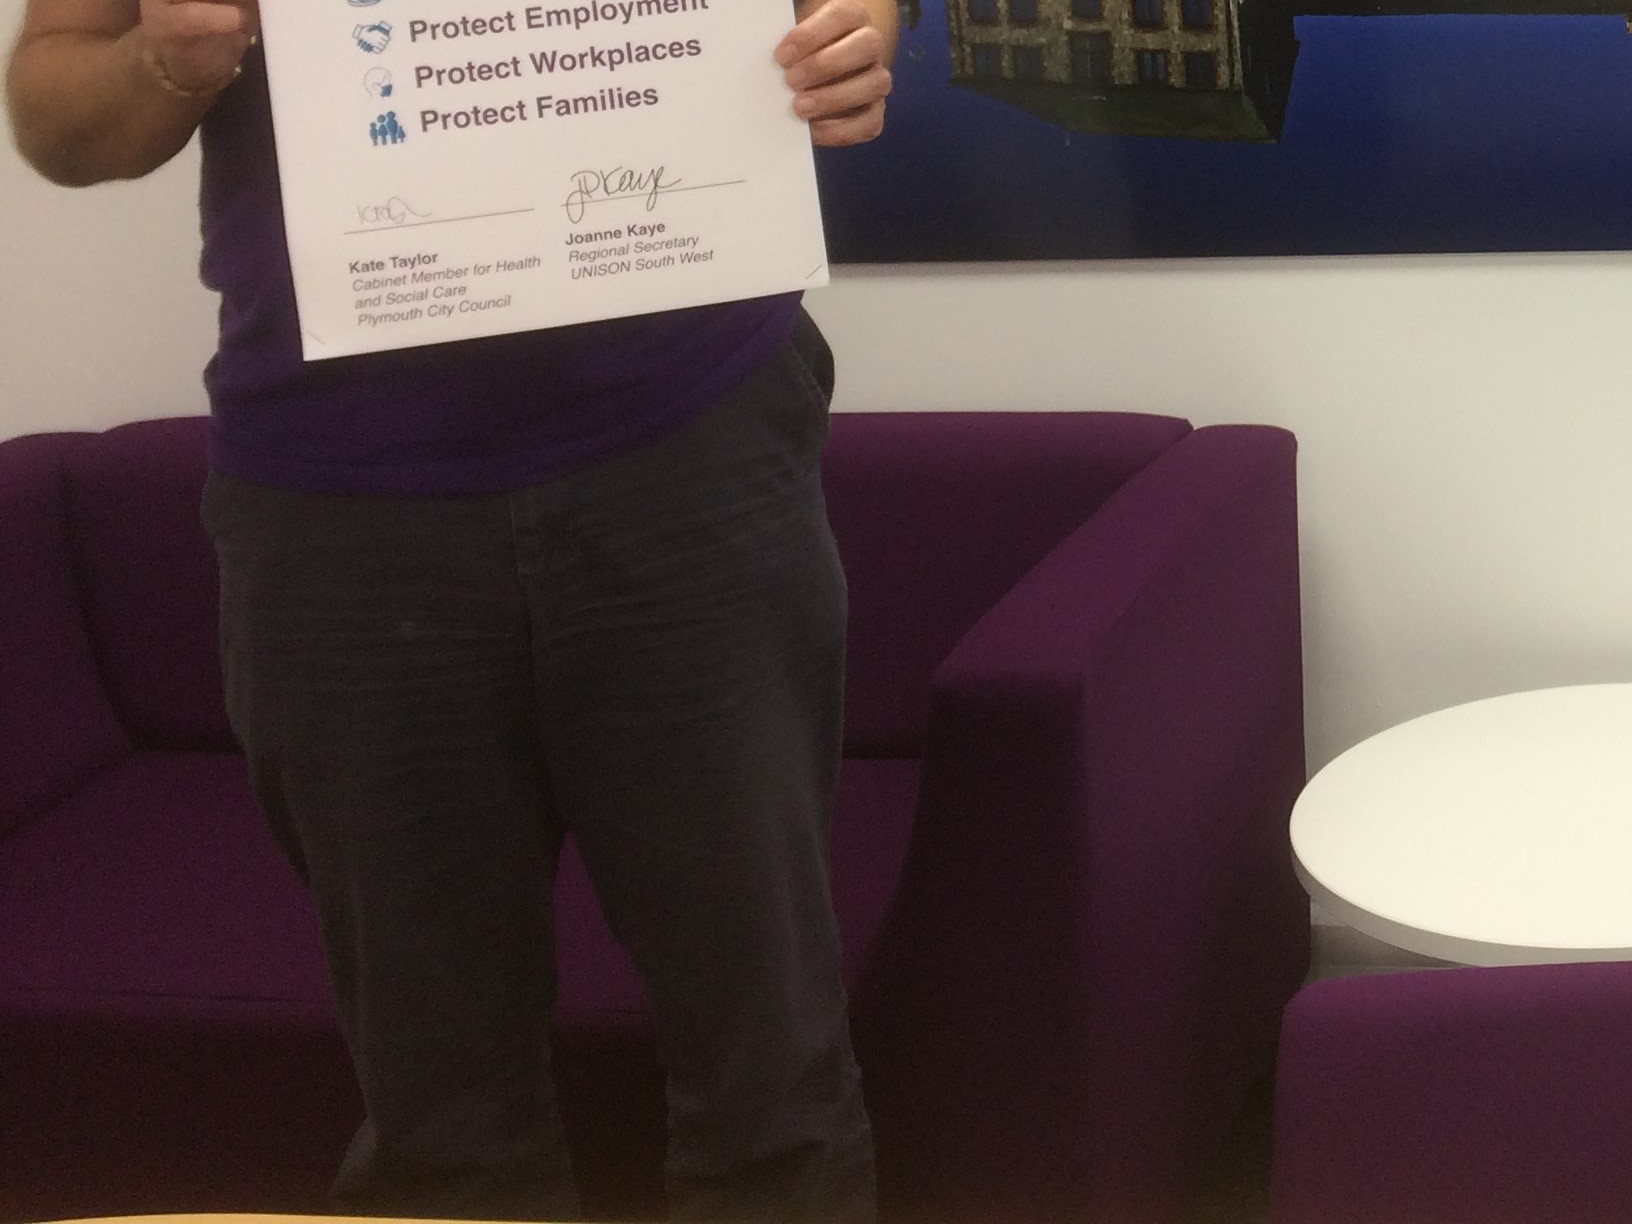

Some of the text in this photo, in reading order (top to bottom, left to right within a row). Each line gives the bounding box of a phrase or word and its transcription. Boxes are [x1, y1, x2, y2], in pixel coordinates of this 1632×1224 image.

[408, 10, 516, 43] Protect
[414, 39, 702, 89] Protect Workplaces
[420, 86, 659, 133] Protect Families
[565, 223, 666, 246] Joanne Kaye
[568, 236, 700, 263] Regional Secretary
[348, 253, 439, 274] Kate Taylor
[352, 255, 541, 292] Cabinet Member for Health
[571, 249, 714, 280] UNISON South West
[354, 285, 467, 310] and Social Care
[357, 294, 512, 328] Plymouth City Council
